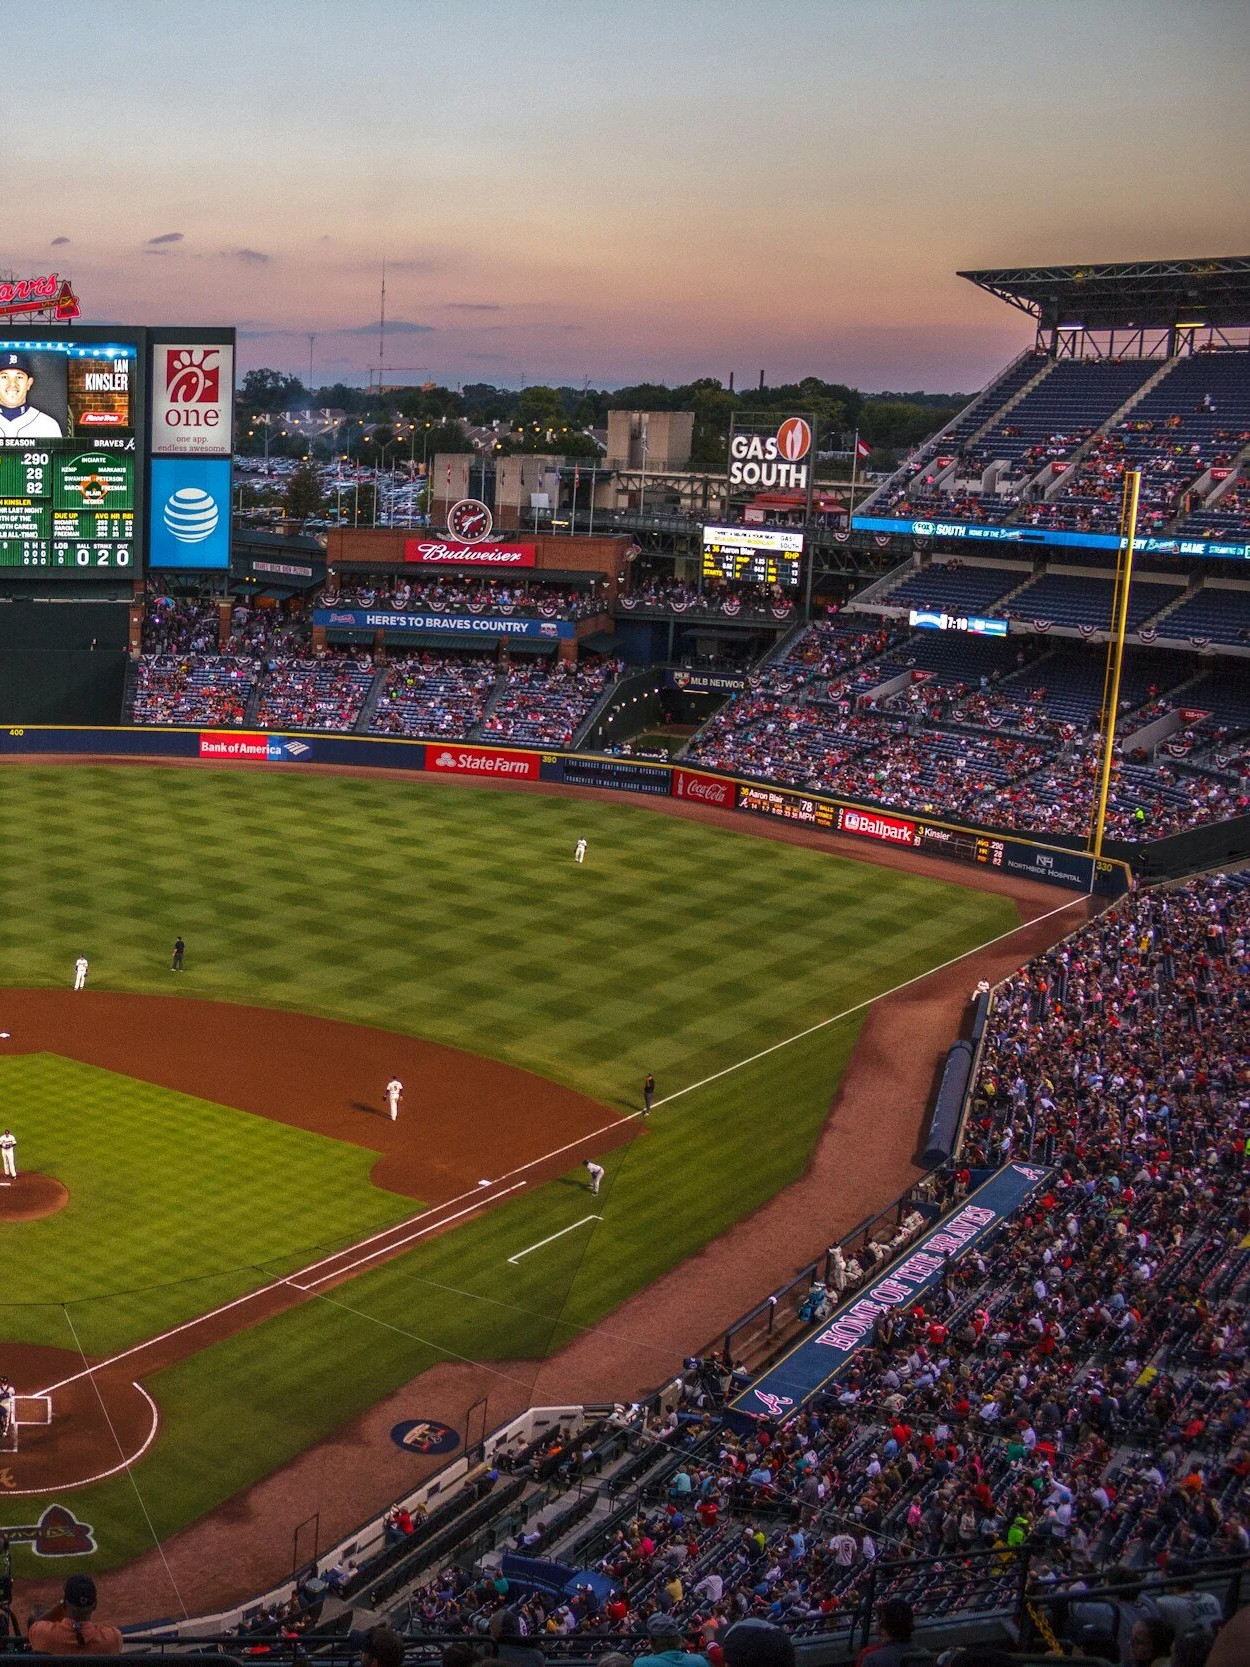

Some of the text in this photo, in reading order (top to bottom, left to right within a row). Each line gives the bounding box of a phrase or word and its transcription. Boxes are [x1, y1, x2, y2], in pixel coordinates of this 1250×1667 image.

[114, 360, 128, 373] IAN
[85, 374, 128, 391] KINSLER
[165, 409, 219, 426] one
[731, 436, 778, 460] GAS
[21, 454, 49, 465] .290
[26, 468, 43, 479] 28
[730, 462, 807, 488] SOUTH
[27, 482, 43, 494] 82
[936, 524, 966, 537] SOUTH
[969, 529, 982, 537] HOME
[417, 543, 521, 562] Budweiser
[1120, 538, 1205, 554] EERY GAME
[77, 549, 89, 565] 0
[97, 549, 109, 565] 2
[117, 550, 129, 565] 0
[367, 615, 407, 626] HERE'S
[408, 617, 424, 627] TO
[426, 617, 470, 629] BRAVES
[472, 621, 529, 633] COUNTRY
[691, 677, 744, 689] MLB NETWOR
[202, 742, 281, 754] Bank of America
[749, 790, 768, 801] Aaron
[768, 793, 784, 803] Blair
[801, 800, 813, 812] 78
[799, 811, 815, 822] MPH
[859, 817, 912, 841] Ballpark
[918, 827, 950, 841] 3 Kinsler
[1008, 860, 1081, 882] NORTHSIDE HOSPITAL
[1096, 861, 1113, 872] 330
[815, 1205, 996, 1351] HOME OF THE BRAVES
